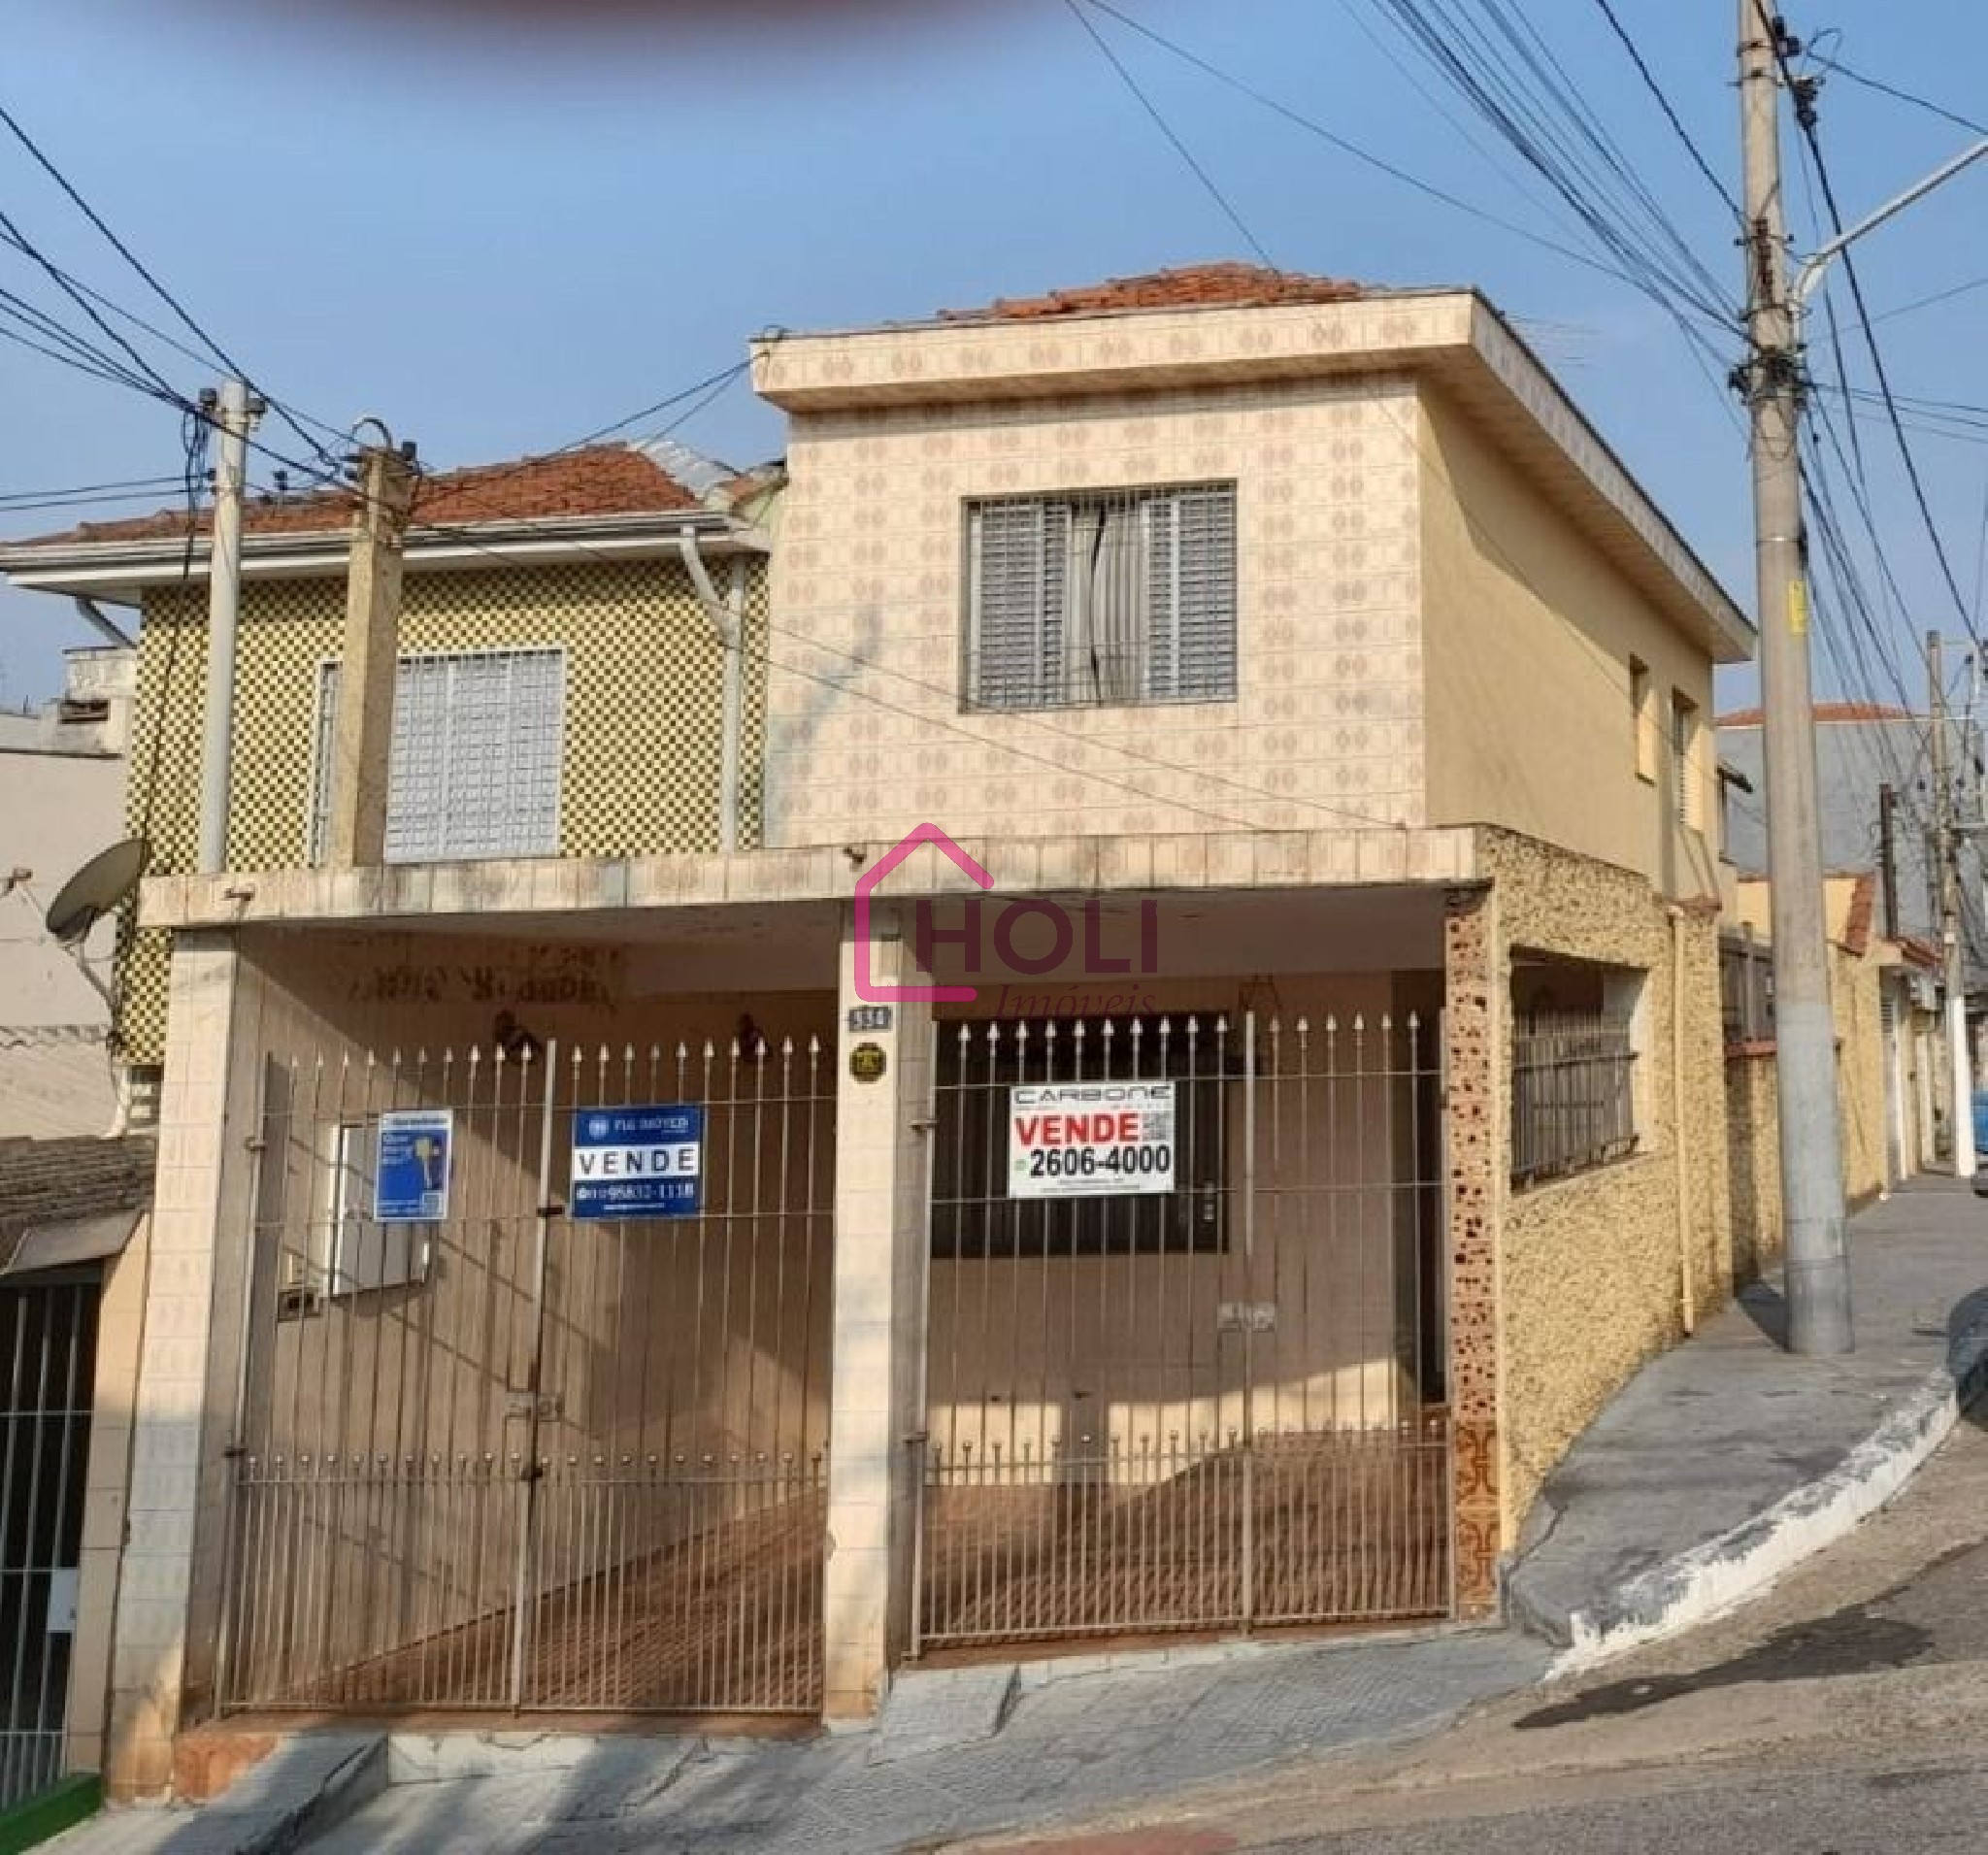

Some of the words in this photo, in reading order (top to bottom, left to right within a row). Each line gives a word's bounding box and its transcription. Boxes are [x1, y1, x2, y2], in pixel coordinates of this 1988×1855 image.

[1014, 1112, 1139, 1145] VENDE
[580, 1148, 695, 1176] VENDE
[1030, 1144, 1171, 1177] 2606-4000
